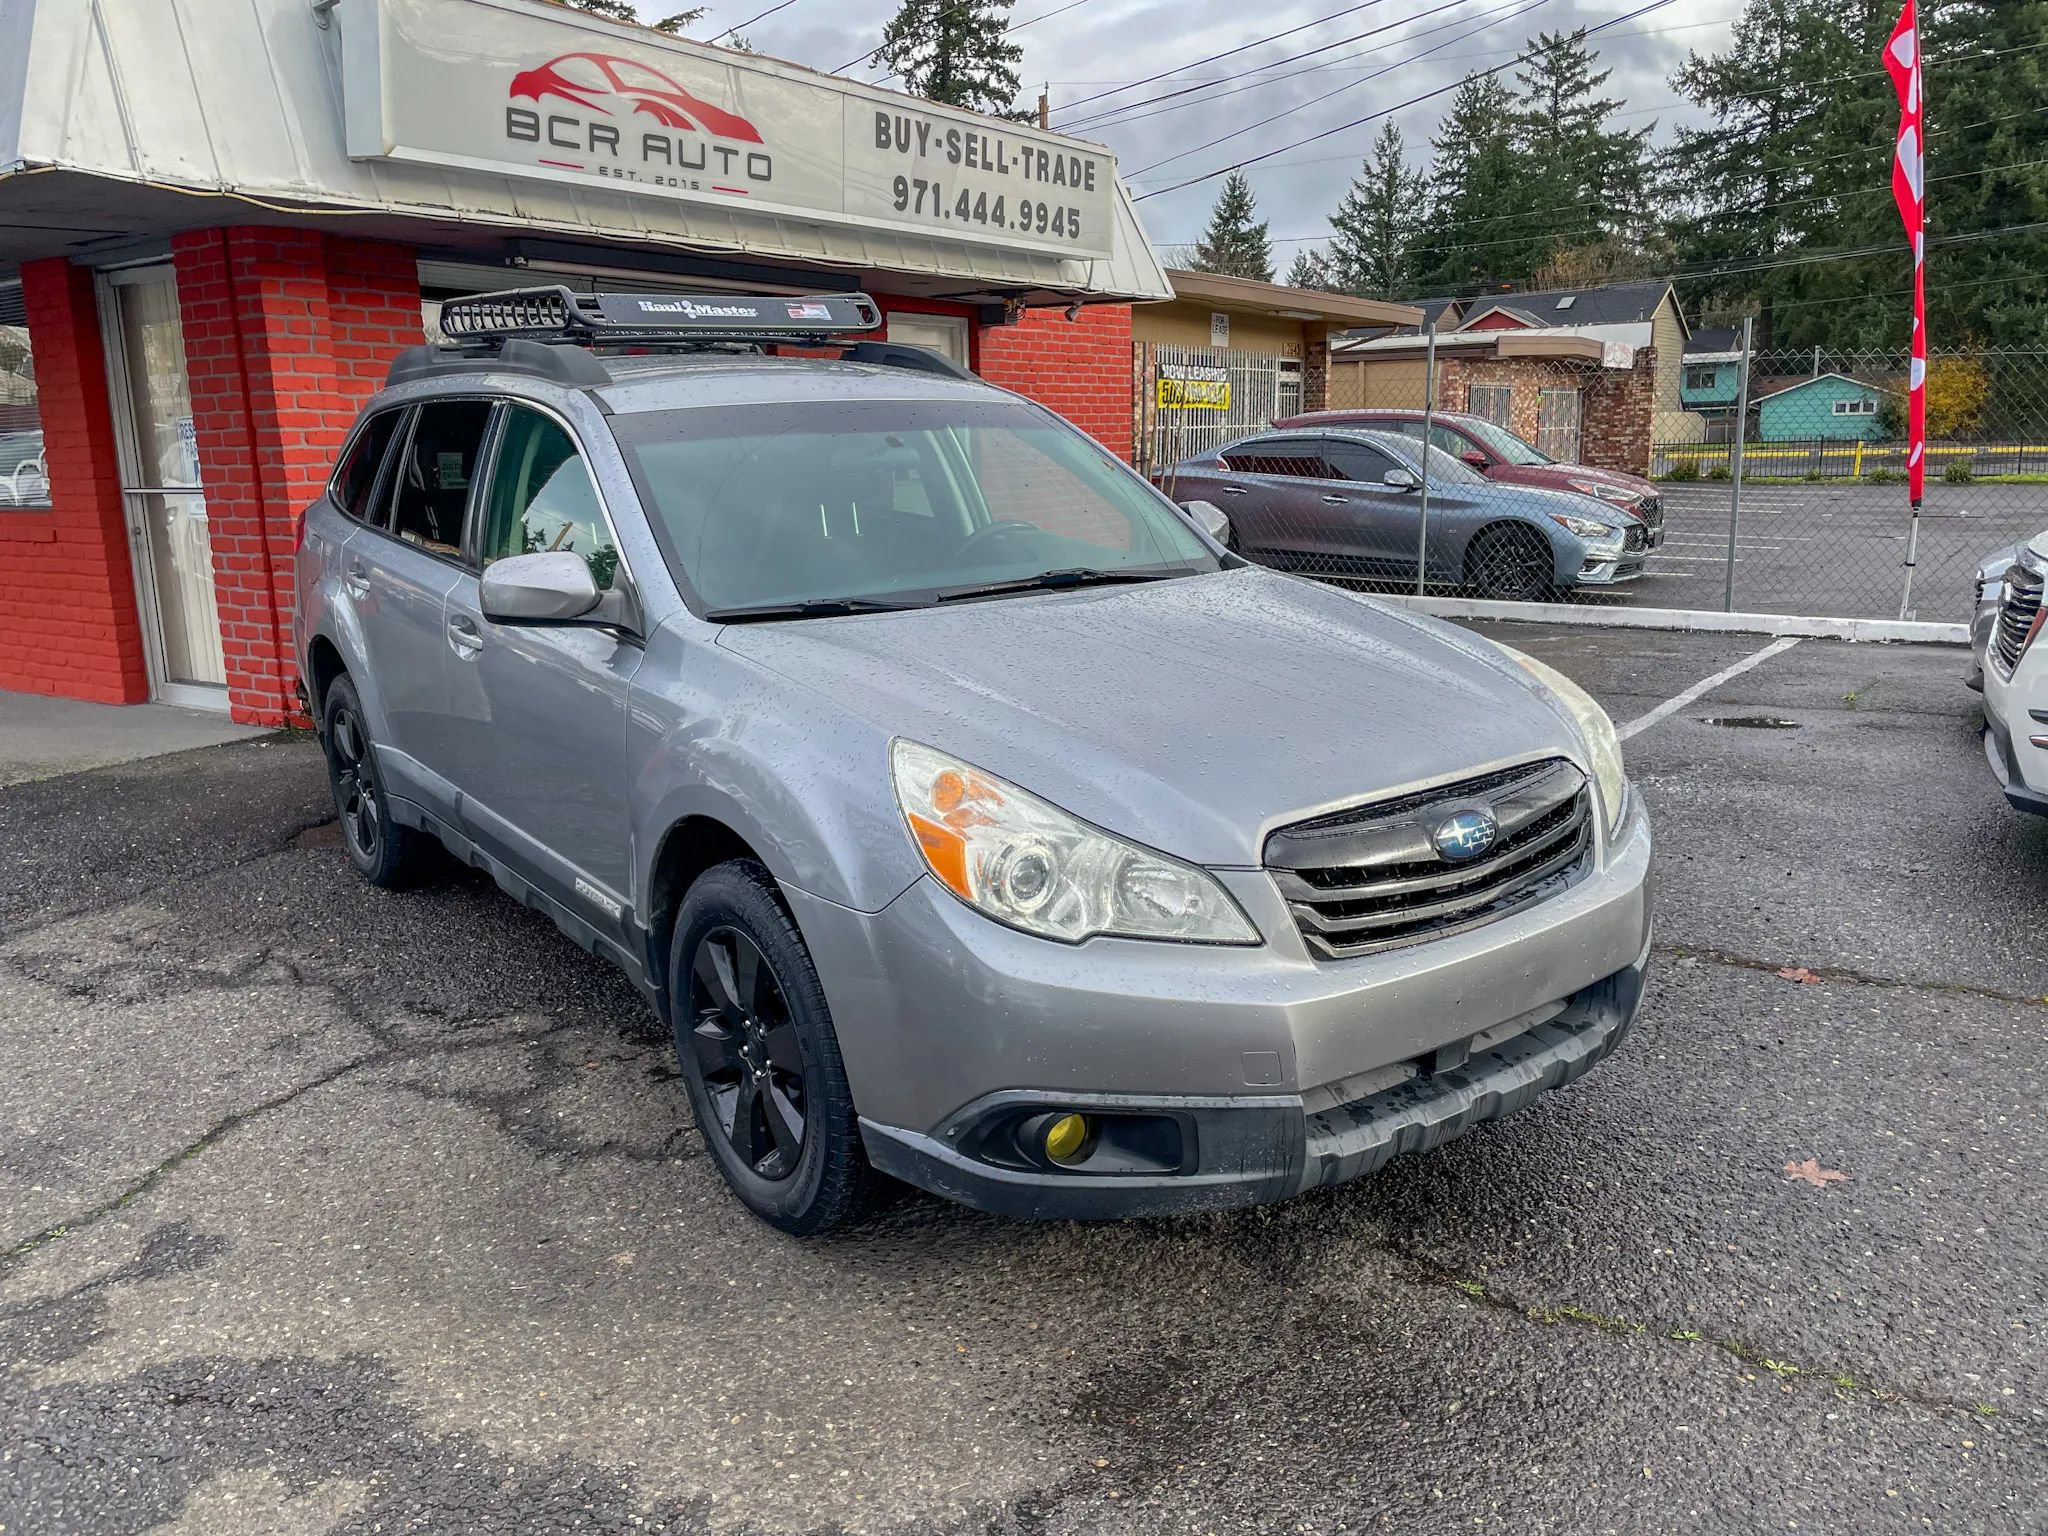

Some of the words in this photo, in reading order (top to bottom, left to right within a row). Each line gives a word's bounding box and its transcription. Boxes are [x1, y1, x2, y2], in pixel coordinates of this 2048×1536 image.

[506, 106, 620, 157] BCR
[642, 132, 772, 182] AUTO
[599, 166, 643, 182] EST.
[655, 175, 700, 190] 2015
[893, 174, 1080, 240] 971.444.9945
[693, 304, 758, 318] Master
[1216, 315, 1225, 324] FOR
[1212, 323, 1228, 336] LEASE
[1162, 363, 1185, 379] NOW
[1188, 365, 1227, 382] LEASING
[180, 422, 196, 440] RES
